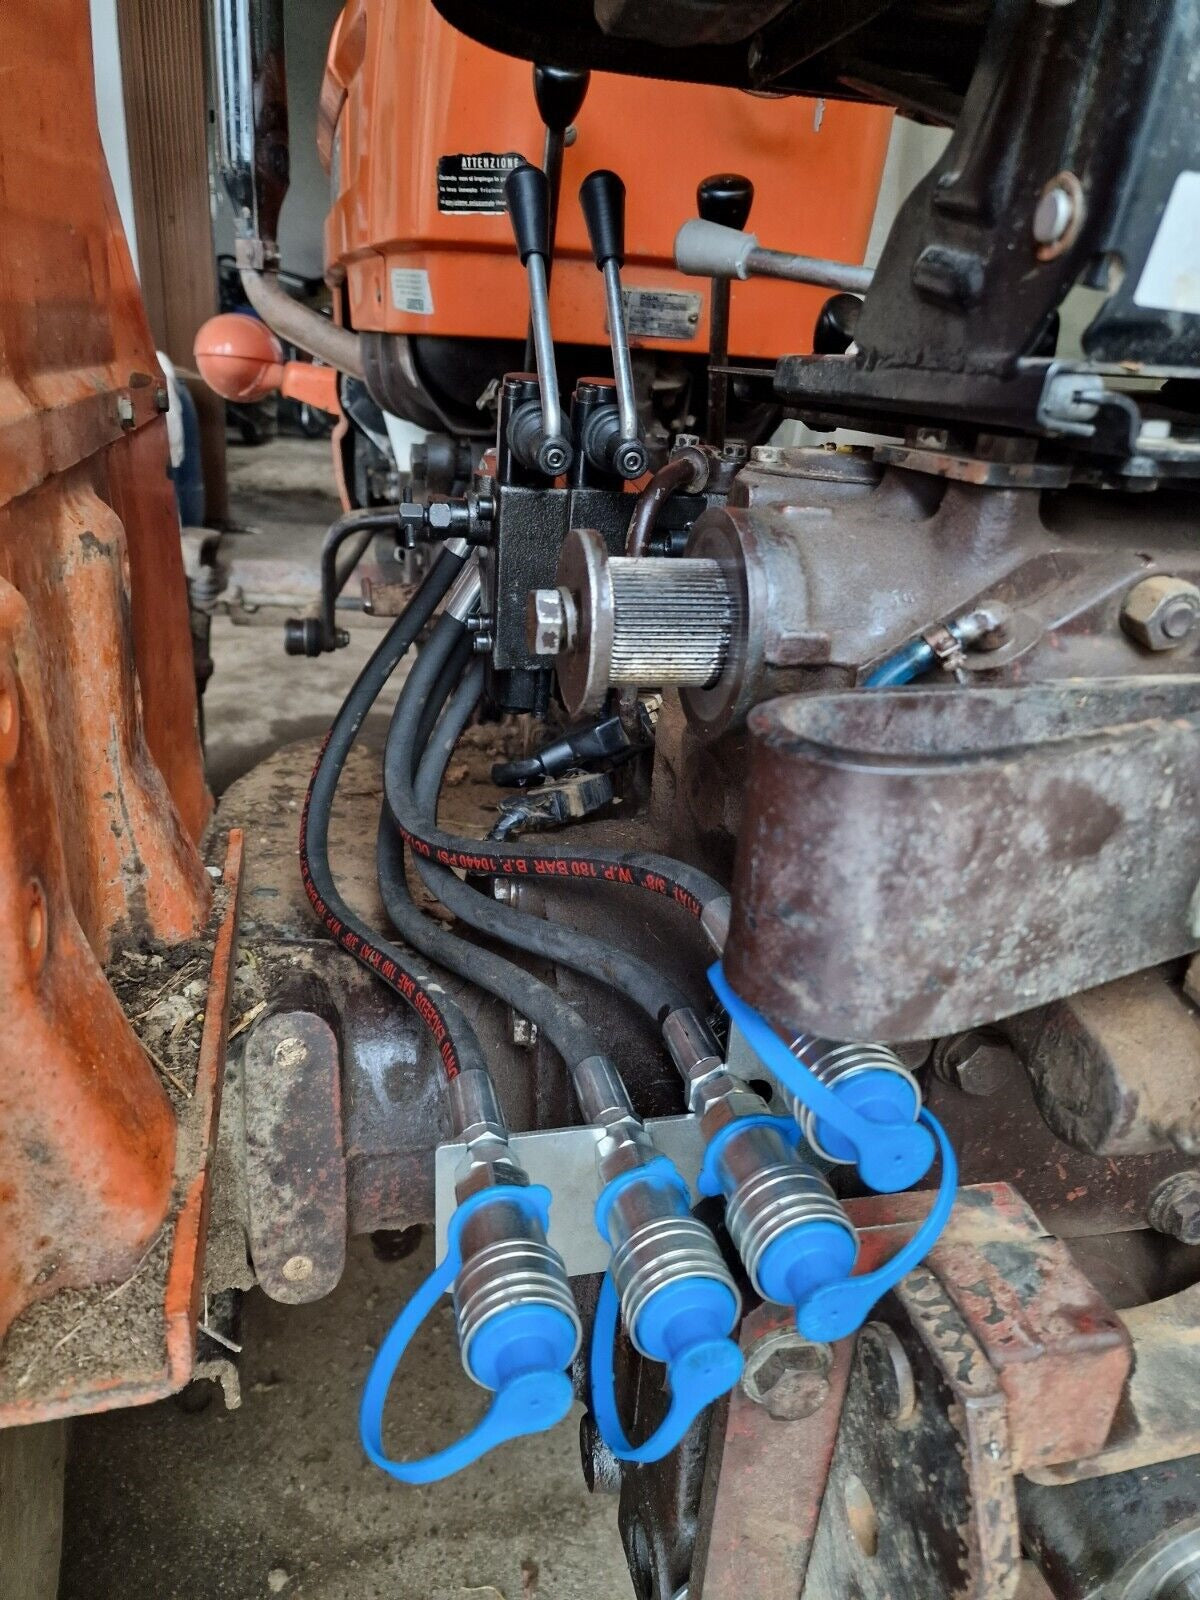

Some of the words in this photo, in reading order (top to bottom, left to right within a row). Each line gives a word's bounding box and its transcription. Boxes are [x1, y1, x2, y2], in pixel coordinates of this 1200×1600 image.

[461, 156, 519, 169] ATTENZIONE
[459, 853, 497, 871] 10440
[500, 857, 528, 874] B.P.
[533, 859, 569, 875] BAR
[571, 860, 597, 877] 180
[601, 864, 634, 884] W.P.
[397, 972, 417, 999] SAE
[414, 991, 447, 1046] EXCEEDS
